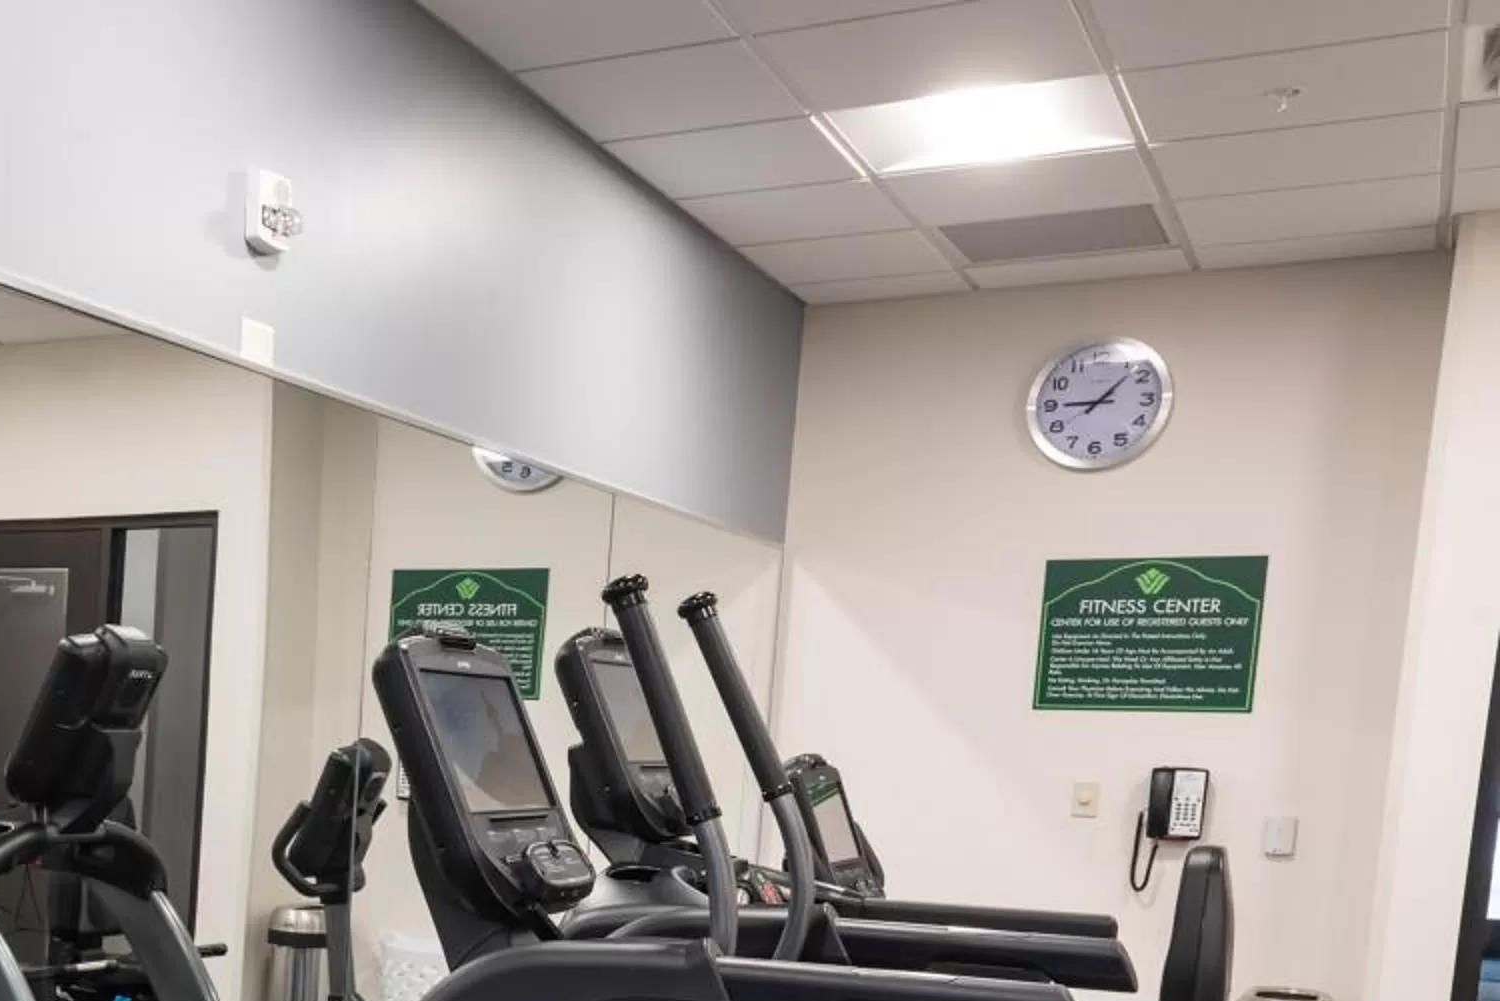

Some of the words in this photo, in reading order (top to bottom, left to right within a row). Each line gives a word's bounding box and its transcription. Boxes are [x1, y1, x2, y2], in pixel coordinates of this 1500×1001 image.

[1071, 360, 1085, 373] 11
[1134, 369, 1150, 384] 2
[1052, 376, 1069, 391] 10
[1043, 400, 1059, 412] 9
[1139, 392, 1155, 407] 3
[1049, 420, 1064, 433] 8
[1132, 414, 1146, 427] 4
[1066, 436, 1079, 449] 7
[1113, 433, 1129, 447] 5
[1087, 441, 1102, 455] 6
[1079, 599, 1147, 615] FITNESS
[1153, 598, 1221, 614] CENTER
[1083, 617, 1102, 627] FOR
[1103, 617, 1120, 627] USE
[1121, 617, 1135, 627] OF
[1223, 617, 1250, 626] ONLY
